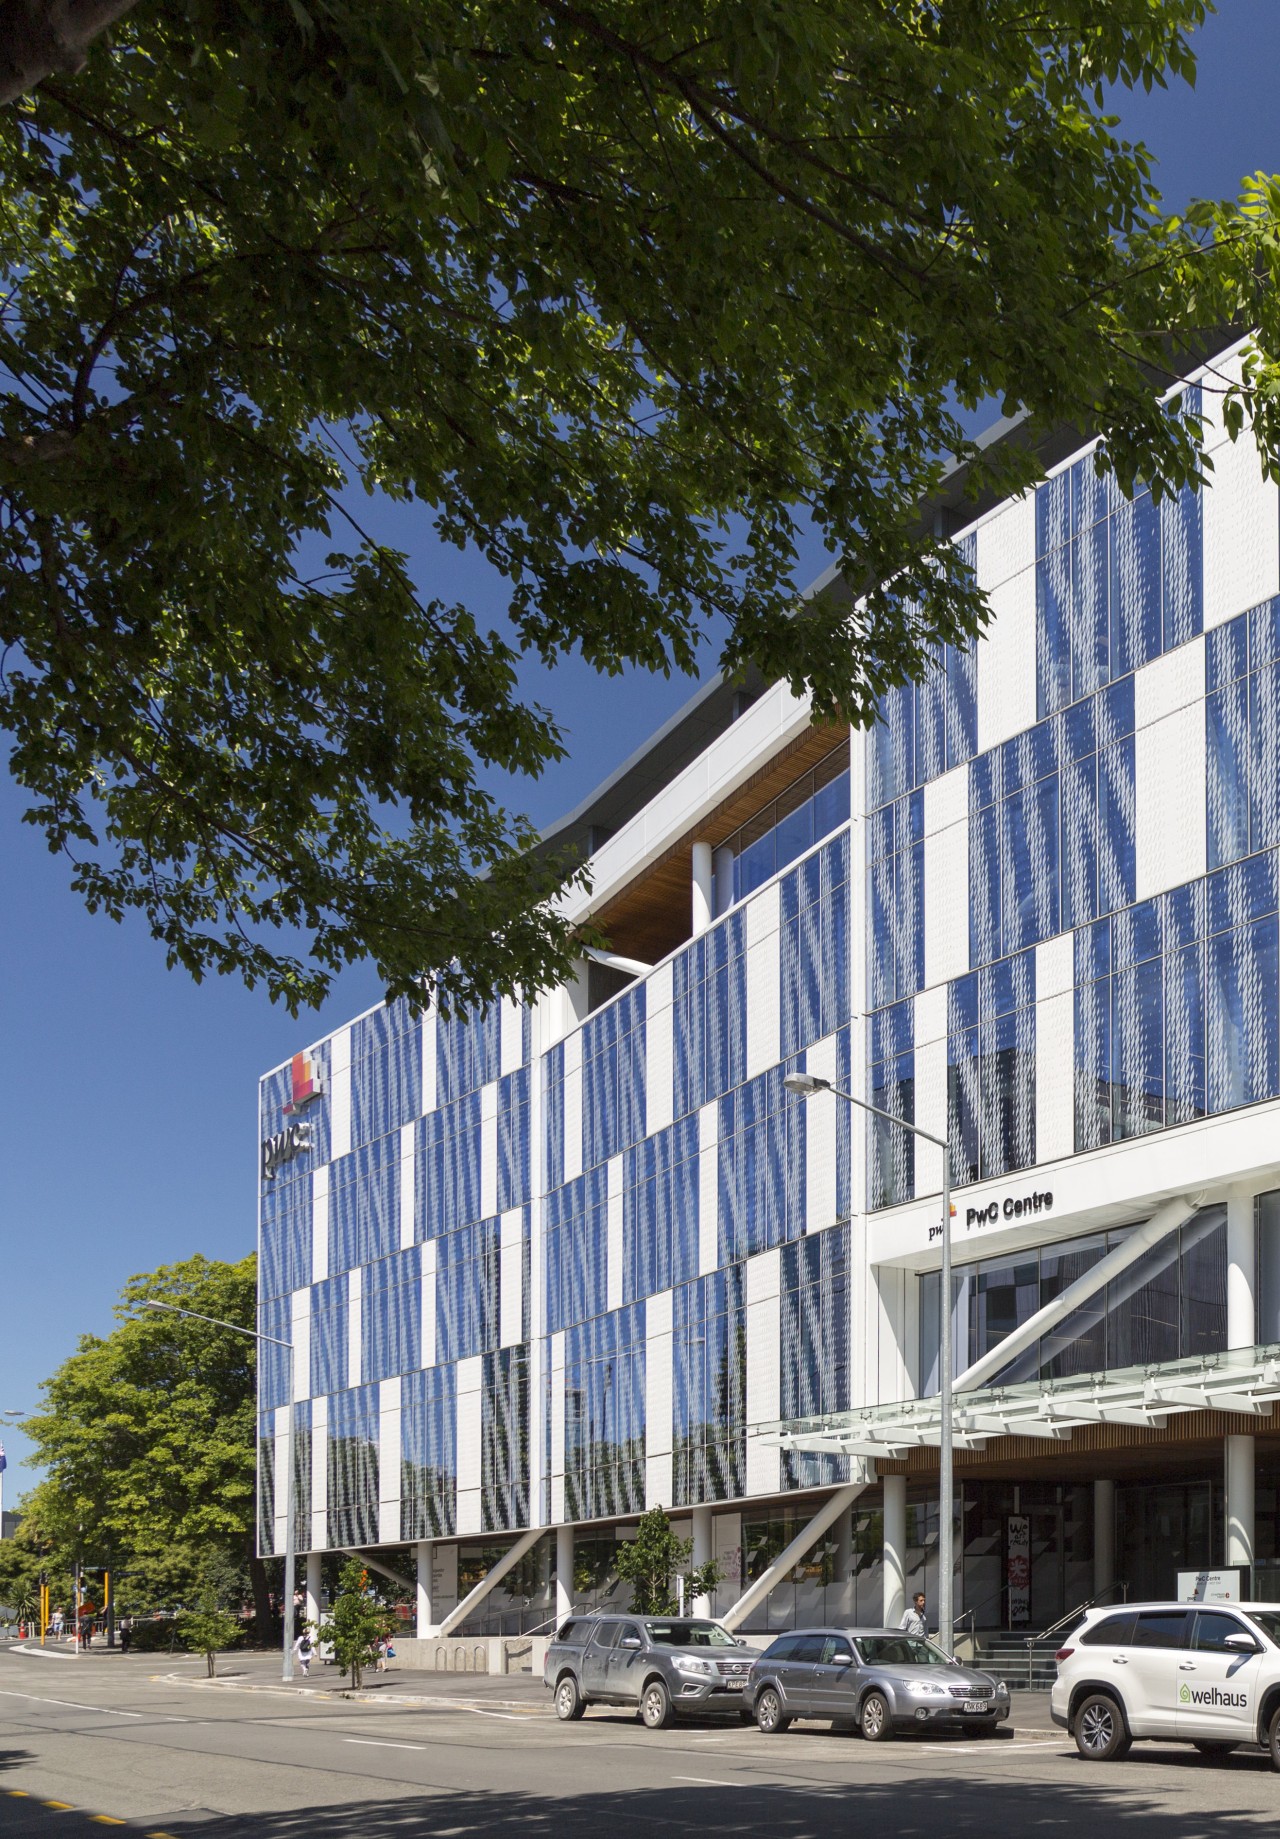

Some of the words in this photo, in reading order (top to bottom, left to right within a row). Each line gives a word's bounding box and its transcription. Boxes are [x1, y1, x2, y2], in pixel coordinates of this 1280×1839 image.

[966, 1202, 999, 1227] PwC
[1003, 1191, 1054, 1217] Centre
[928, 1225, 944, 1241] pw
[1191, 1687, 1248, 1708] welhaus
